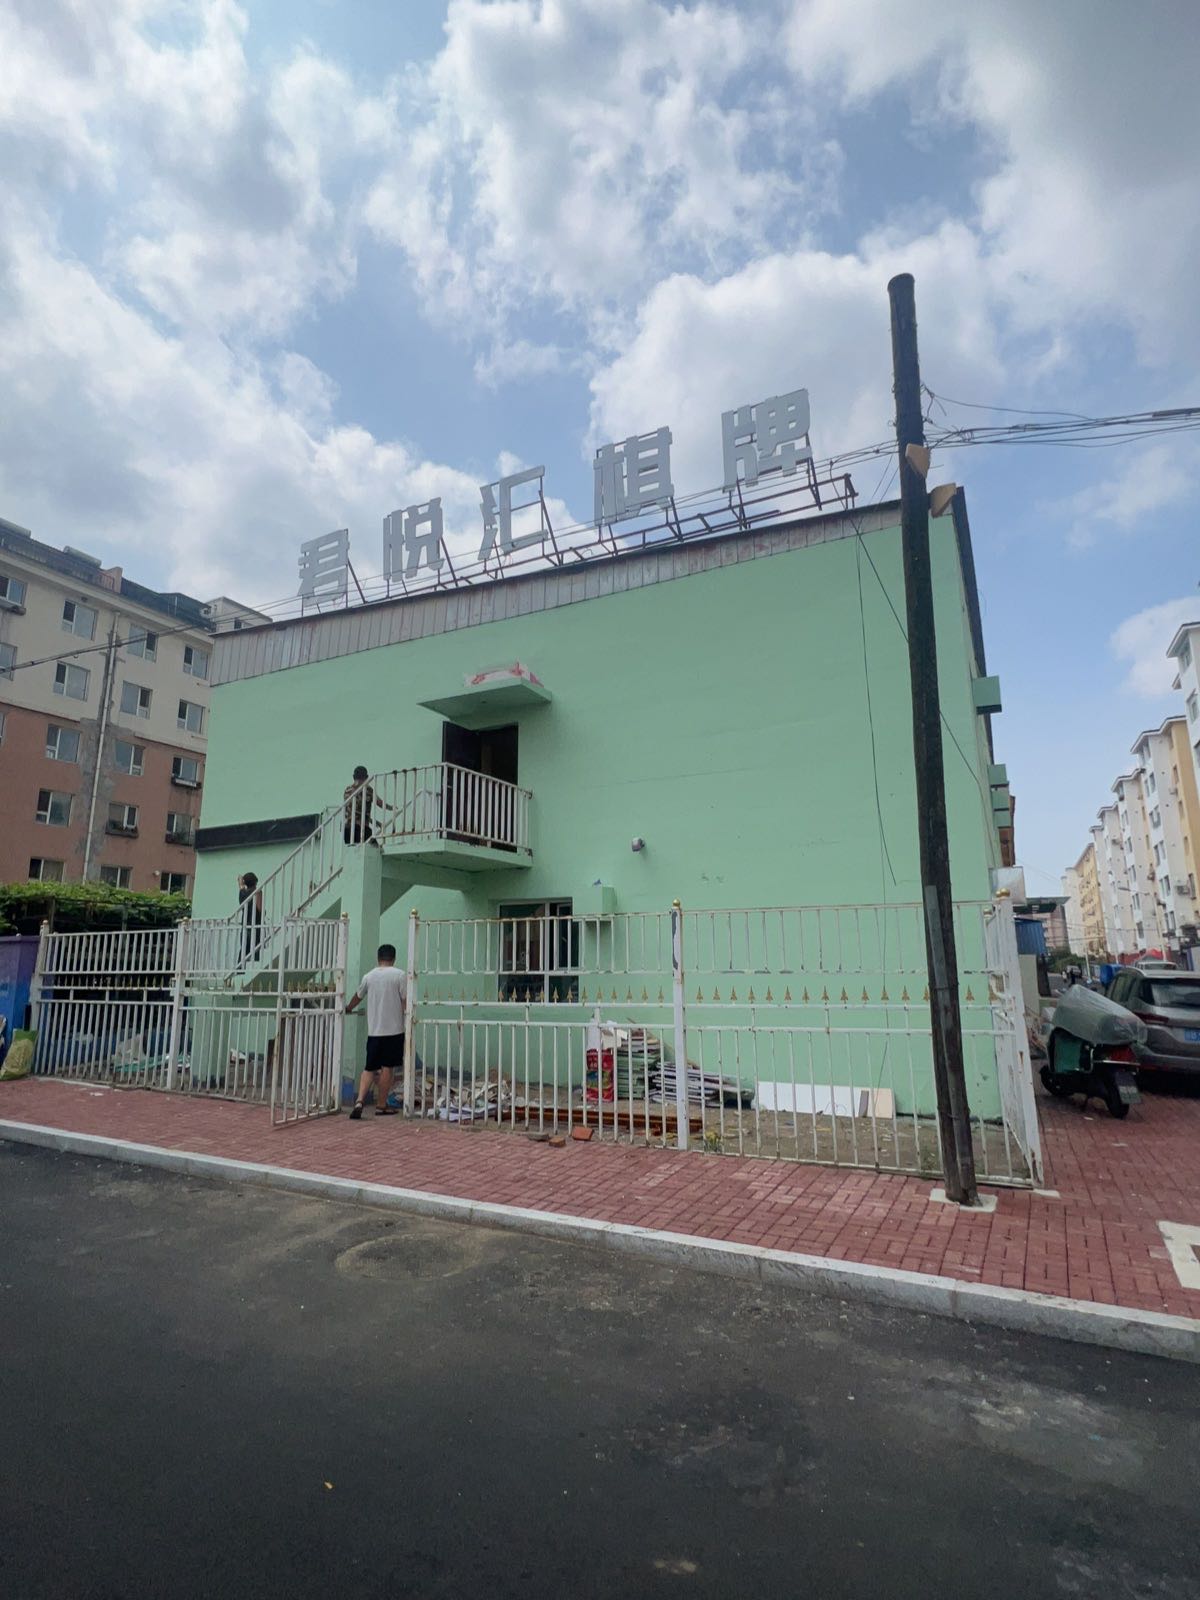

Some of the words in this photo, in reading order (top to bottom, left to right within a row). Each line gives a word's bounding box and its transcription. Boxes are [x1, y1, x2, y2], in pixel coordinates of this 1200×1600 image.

[297, 387, 812, 607] 君悦汇棋牌
